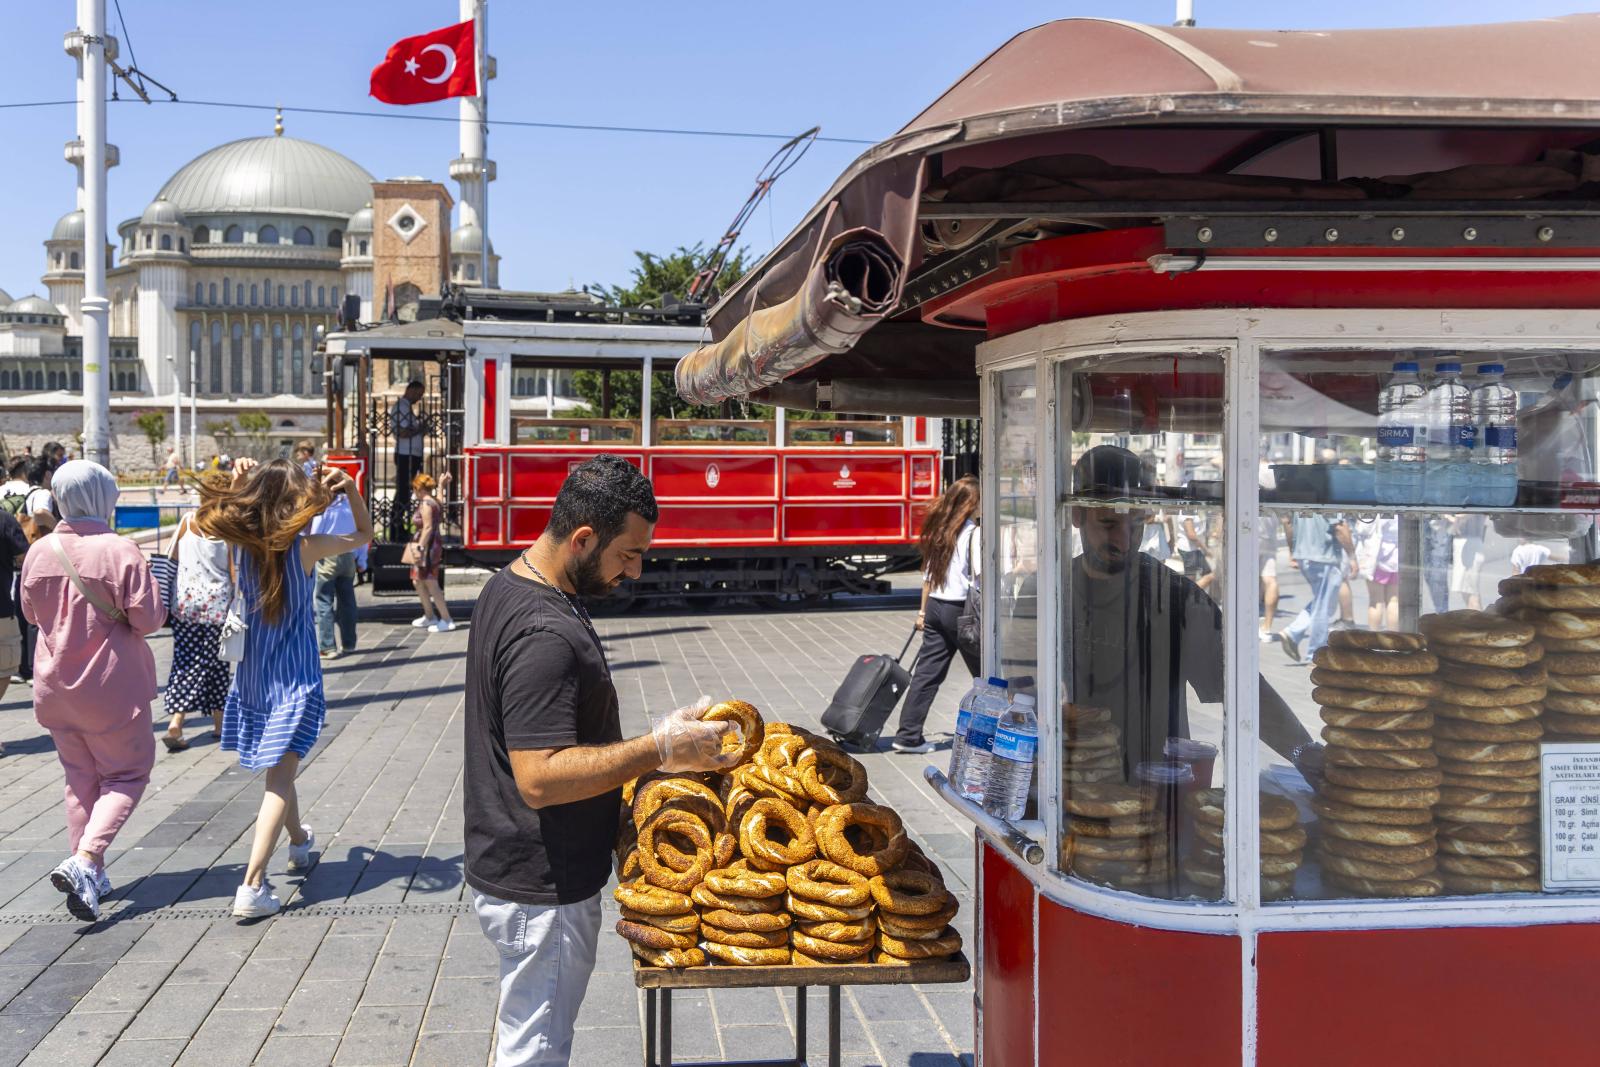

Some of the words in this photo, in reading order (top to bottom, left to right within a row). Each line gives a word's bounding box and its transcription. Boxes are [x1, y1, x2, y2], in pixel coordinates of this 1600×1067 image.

[1580, 794, 1599, 804] CİNSİ
[1581, 821, 1599, 829] Açma
[1581, 832, 1598, 841] Çatal
